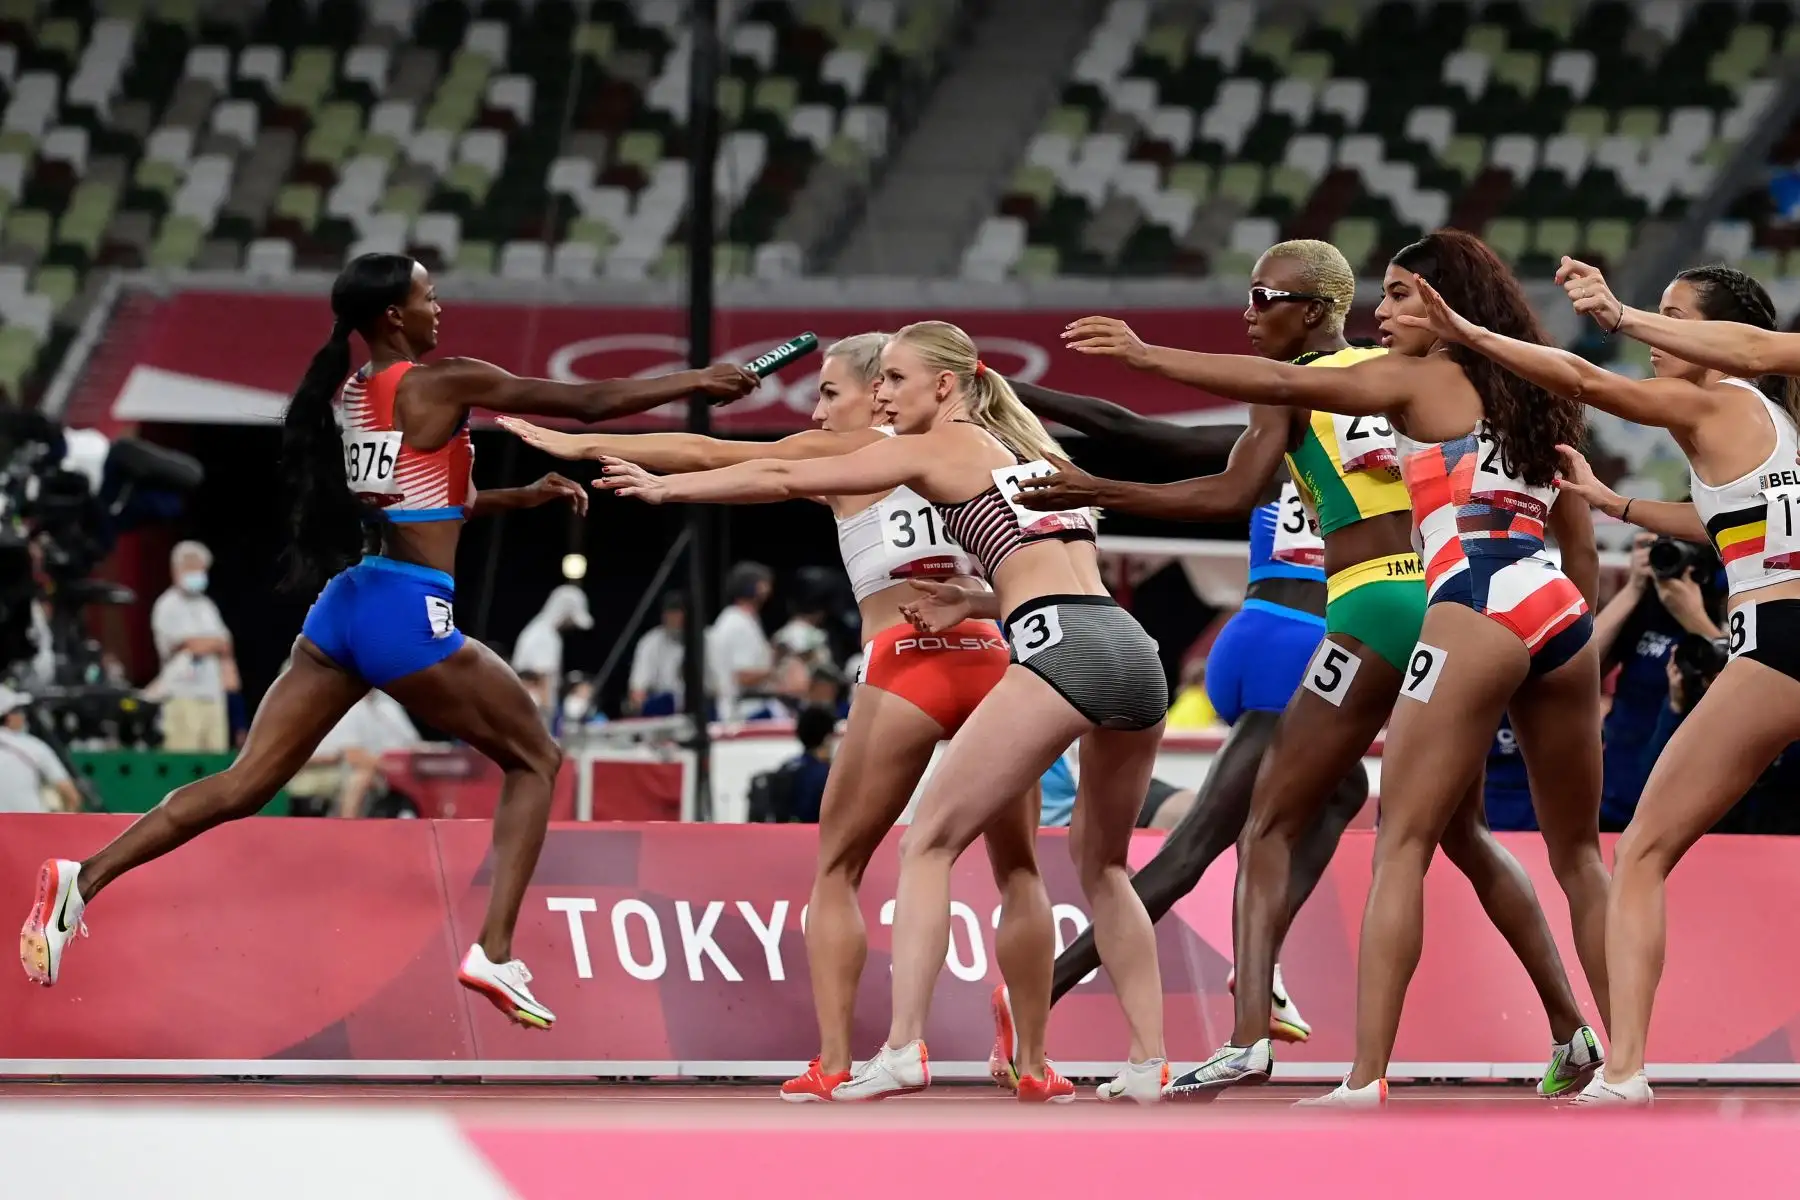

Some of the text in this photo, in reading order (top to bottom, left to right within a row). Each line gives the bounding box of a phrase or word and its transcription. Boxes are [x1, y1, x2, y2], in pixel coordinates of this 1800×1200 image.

[755, 342, 798, 368] TOKYO
[1769, 470, 1800, 488] BEL
[435, 601, 451, 632] 7
[1023, 613, 1051, 649] 3
[1730, 611, 1746, 654] 8
[1314, 648, 1349, 692] 5
[1408, 650, 1433, 692] 9
[546, 897, 809, 982] TOKY
